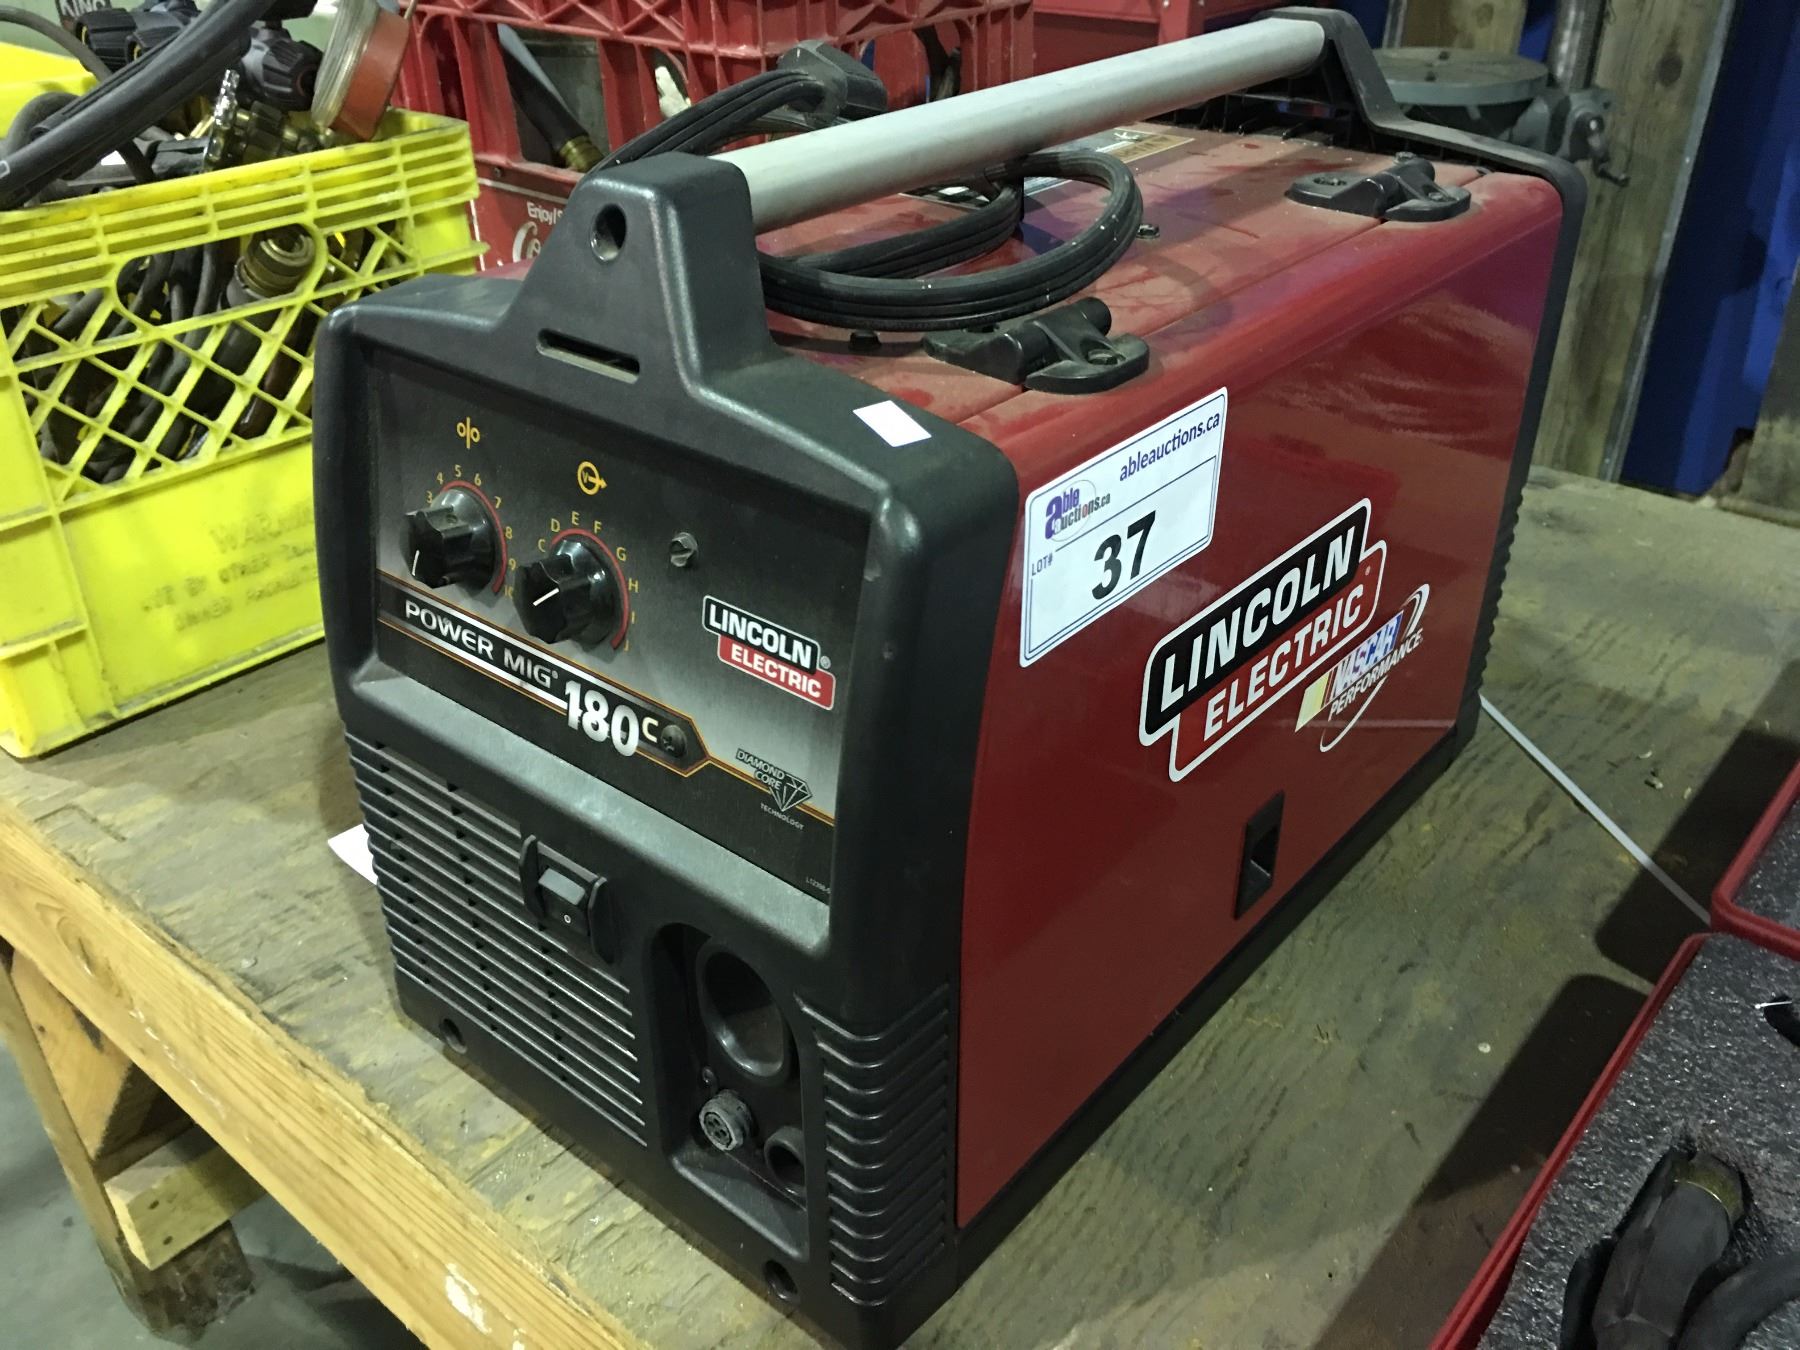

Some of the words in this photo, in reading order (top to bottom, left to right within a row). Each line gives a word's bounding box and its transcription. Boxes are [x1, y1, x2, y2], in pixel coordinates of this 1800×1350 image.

[1119, 412, 1221, 482] ableauctions.ca
[436, 471, 444, 485] 4
[454, 464, 462, 478] 5
[474, 473, 482, 487] 6
[494, 495, 502, 509] 7
[505, 526, 513, 540] 8
[508, 558, 517, 571] 9
[537, 538, 546, 553] C
[550, 518, 560, 533] D
[571, 510, 580, 526] E
[593, 520, 603, 534] F
[616, 546, 627, 562] G
[628, 577, 639, 593] H
[1031, 552, 1053, 577] LOT#
[1092, 510, 1157, 601] 37
[405, 599, 494, 661] POWER
[1160, 525, 1357, 713] LINCOLN
[709, 603, 812, 670] LINCOLN
[731, 643, 822, 699] ELECTRIC
[1203, 583, 1365, 743] ELECTRIC
[1328, 628, 1424, 723] PERFORMANCE
[737, 750, 786, 780] DIAMOND
[754, 769, 783, 791] CORE
[760, 802, 805, 832] TECHNOLOGY
